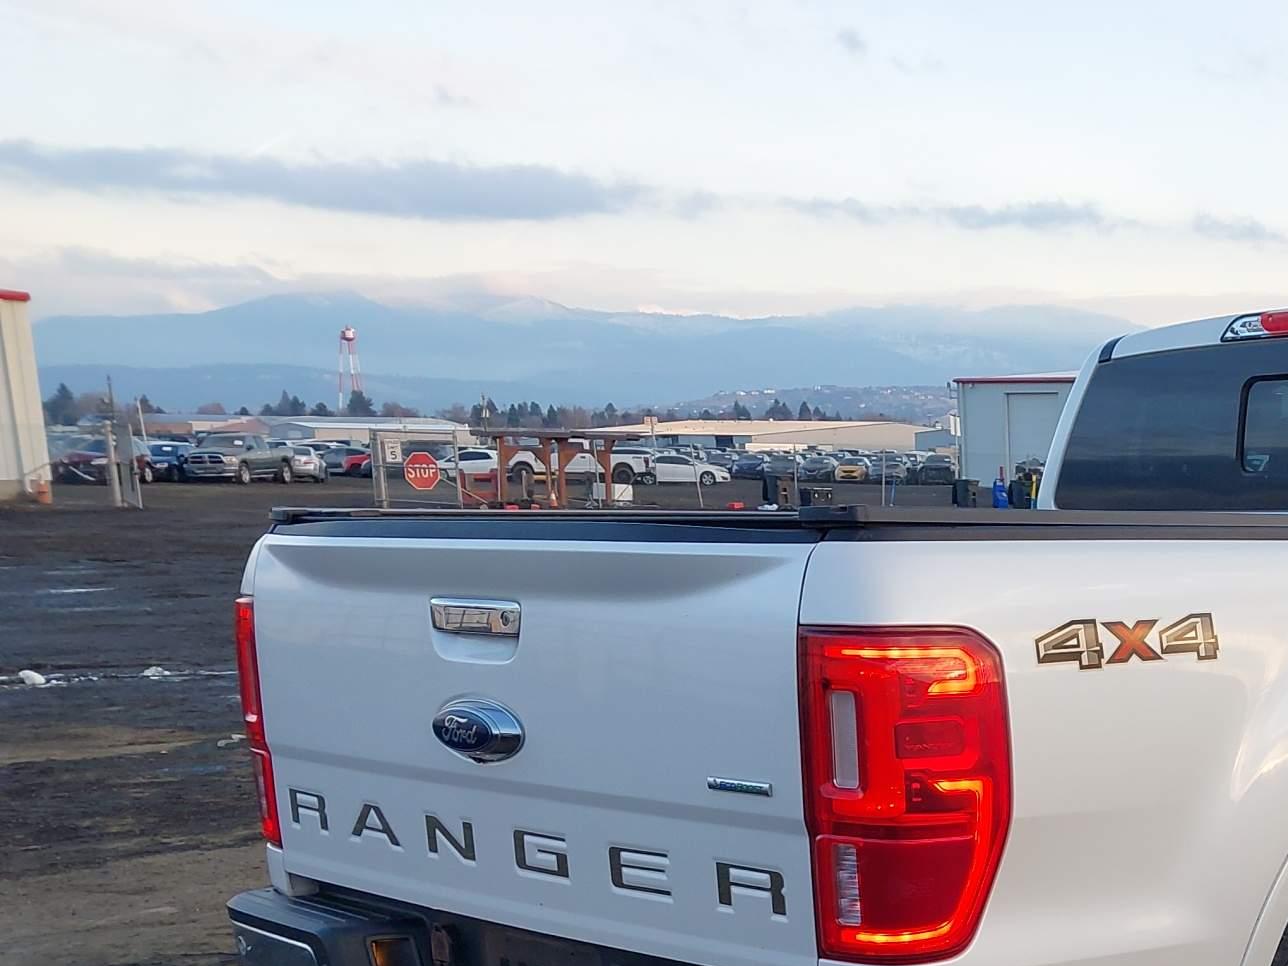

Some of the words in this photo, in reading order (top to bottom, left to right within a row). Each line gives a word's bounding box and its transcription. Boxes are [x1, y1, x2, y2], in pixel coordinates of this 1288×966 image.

[390, 450, 398, 460] 5
[407, 464, 436, 479] STOP
[441, 715, 478, 744] Ford
[288, 787, 787, 917] RANGER
